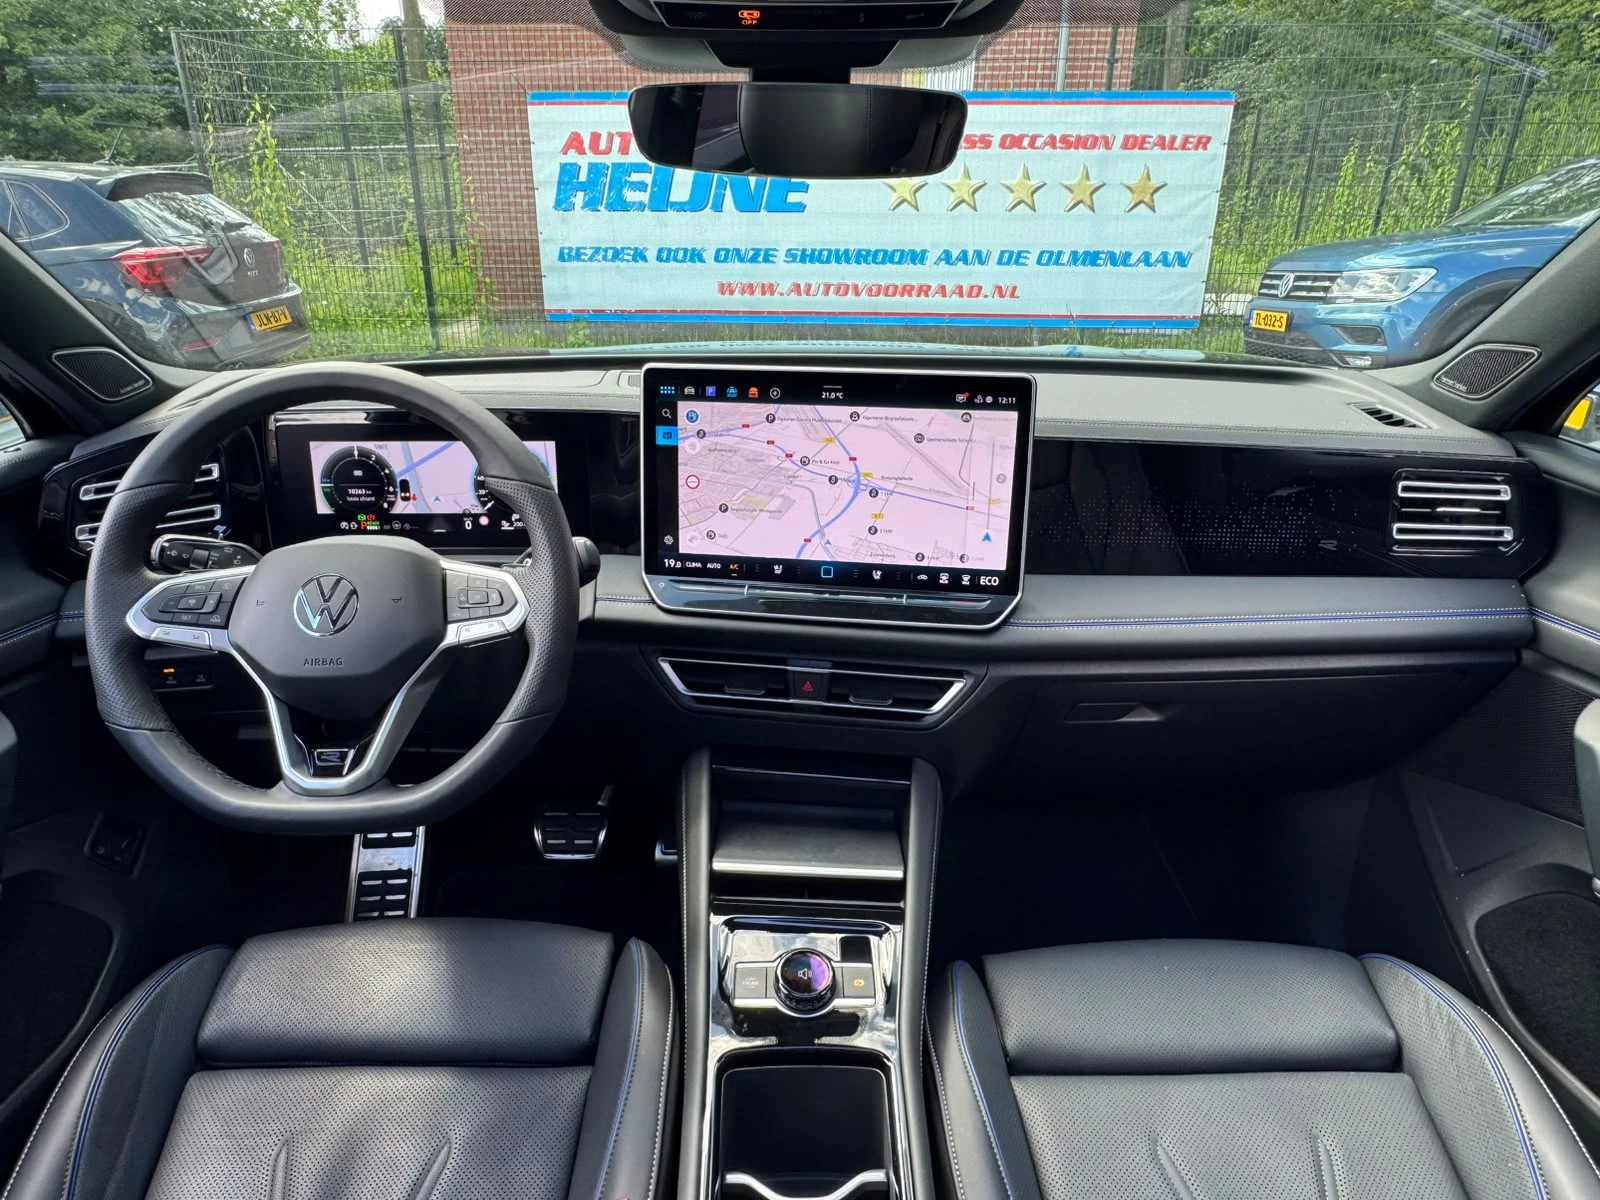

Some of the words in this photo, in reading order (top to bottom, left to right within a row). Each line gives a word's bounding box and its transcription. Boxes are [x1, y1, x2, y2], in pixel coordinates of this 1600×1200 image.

[959, 133, 994, 150] SS
[998, 133, 1116, 150] OCCASION
[1120, 134, 1213, 151] DEALER
[557, 246, 649, 263] BEZOEK
[655, 247, 708, 263] OOK
[713, 247, 780, 264] ONZE
[783, 248, 929, 265] SHOWROOM
[934, 249, 993, 266] AAN
[996, 249, 1032, 266] DE
[1035, 250, 1194, 268] OLMENLAAN
[717, 280, 1021, 299] WWW.AUTOVOORRAAD.NL
[998, 396, 1016, 404] 12:11
[979, 576, 999, 586] ECO
[304, 657, 344, 667] AIRBAG
